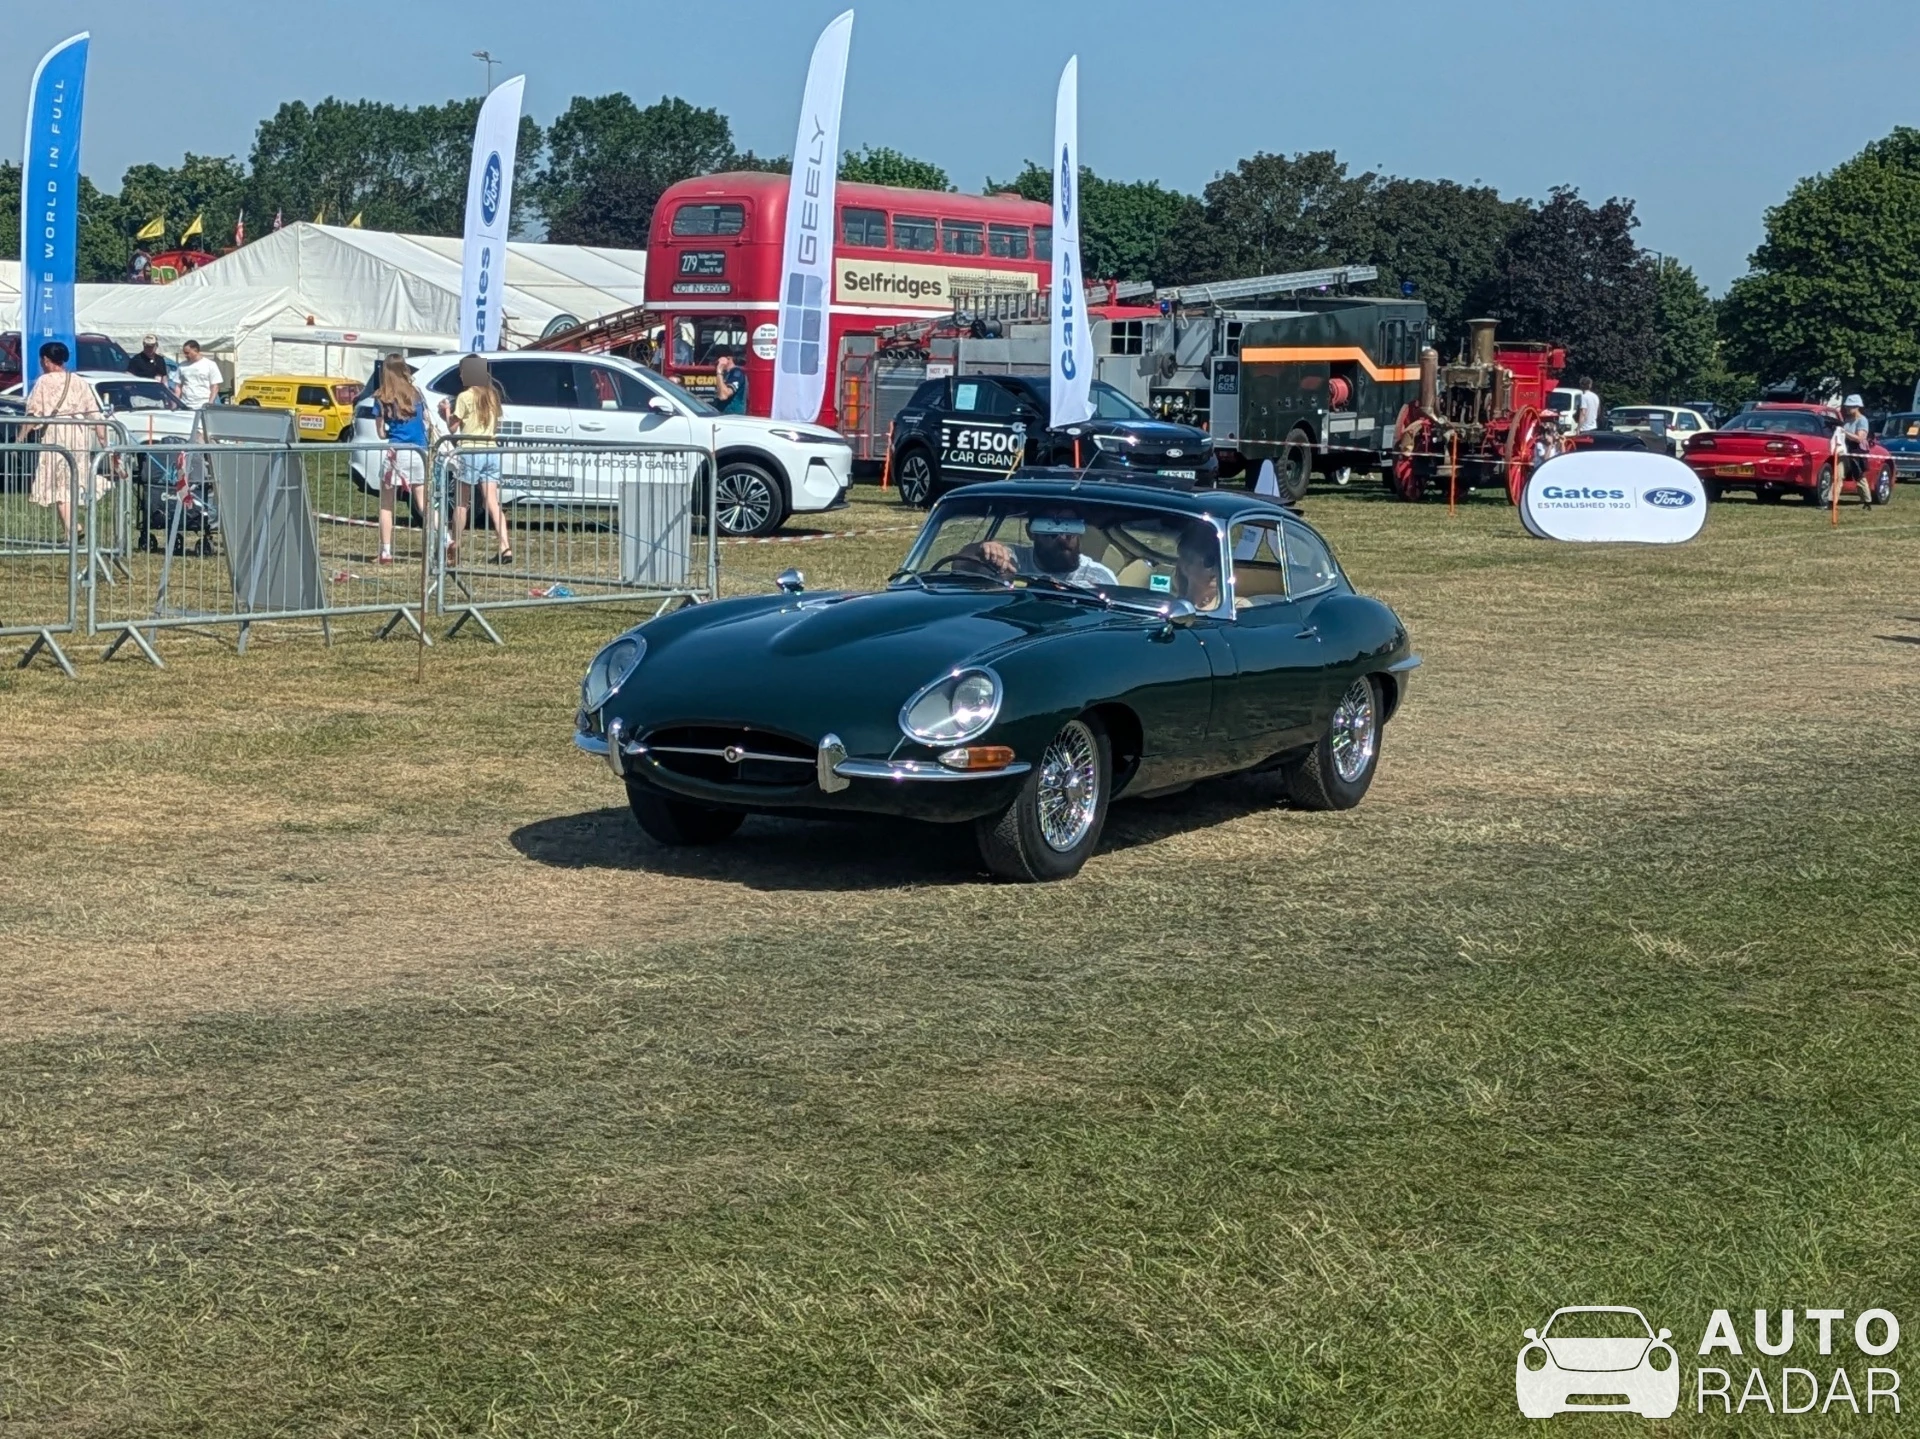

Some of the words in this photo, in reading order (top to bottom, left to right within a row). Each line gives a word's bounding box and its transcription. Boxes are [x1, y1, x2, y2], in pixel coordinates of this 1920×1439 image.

[52, 79, 65, 134] FULL
[49, 147, 60, 168] IN
[483, 165, 500, 213] Ford
[798, 114, 825, 265] GEELY
[44, 181, 58, 259] WORLD
[681, 255, 698, 272] 279
[43, 272, 54, 313] THE
[674, 284, 690, 293] NOT
[693, 284, 701, 293] IN
[703, 284, 729, 293] SERVICE
[844, 270, 942, 299] Selfridges
[1217, 382, 1235, 391] 605
[1218, 374, 1236, 383] PGW
[524, 424, 571, 434] GEELY
[526, 456, 592, 468] WALTHAM
[594, 458, 638, 469] CROSS
[644, 460, 688, 471] GATES
[949, 450, 975, 463] CAR
[1542, 486, 1625, 499] Gates
[1653, 490, 1685, 506] Ford
